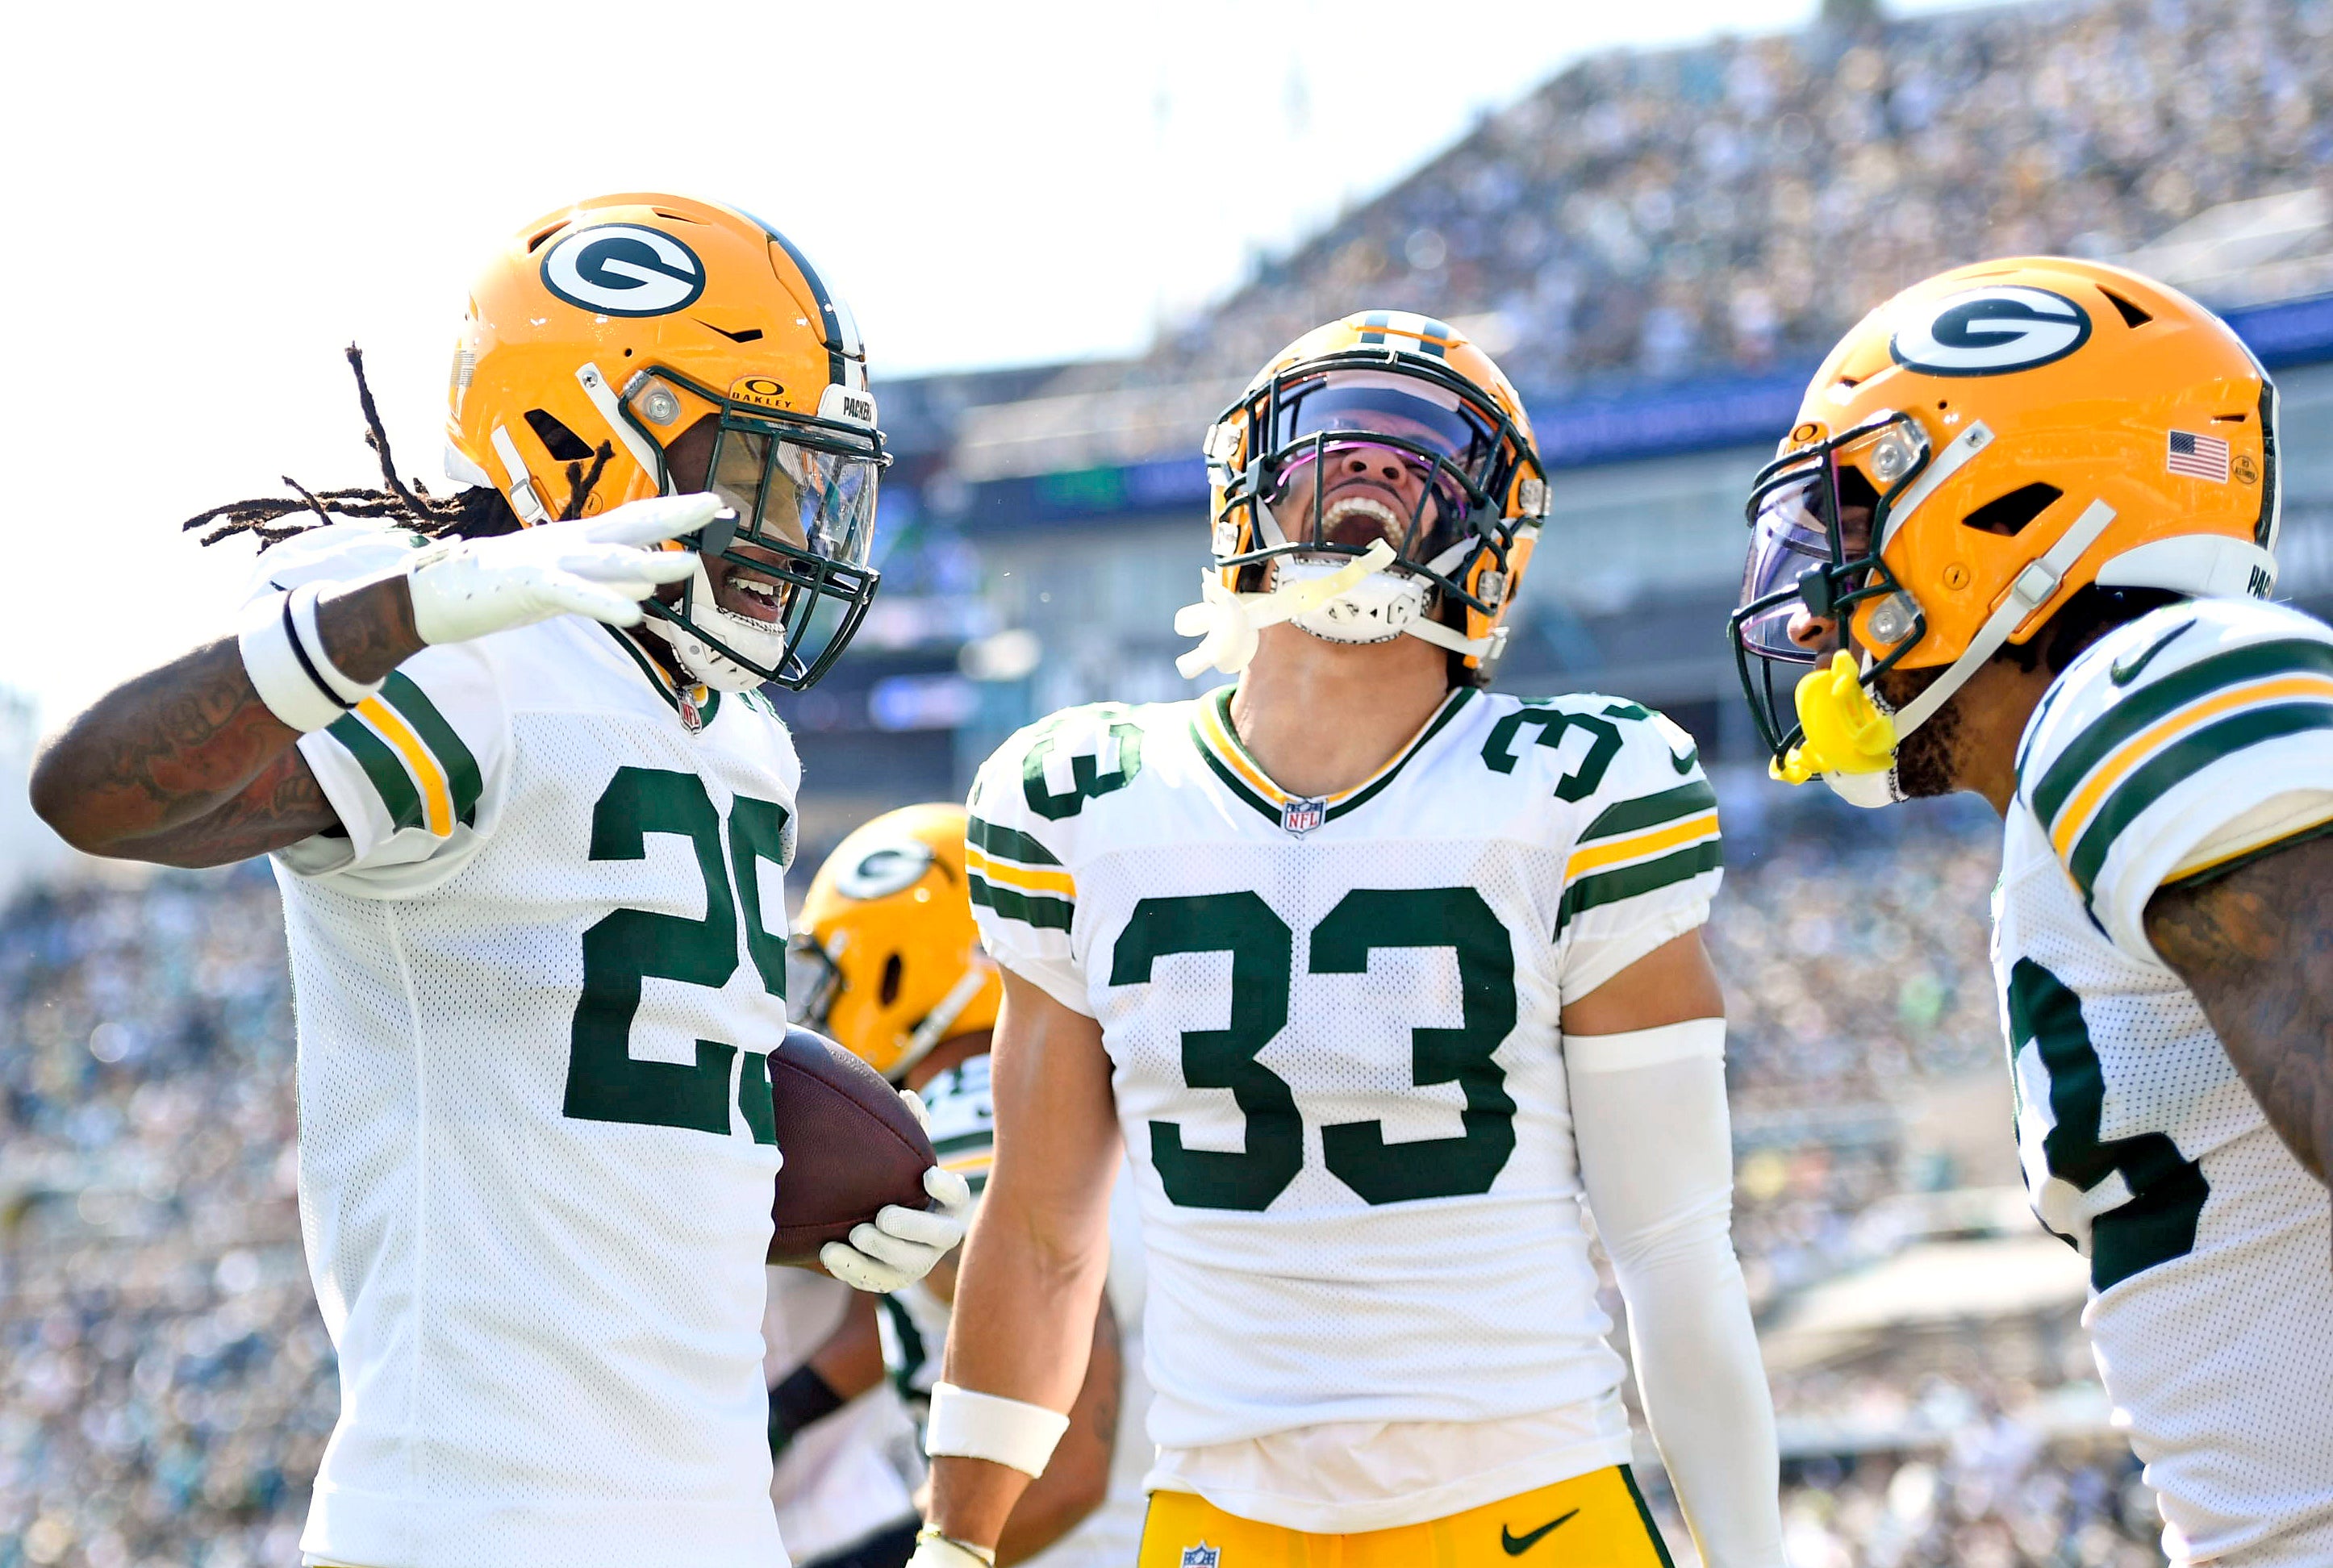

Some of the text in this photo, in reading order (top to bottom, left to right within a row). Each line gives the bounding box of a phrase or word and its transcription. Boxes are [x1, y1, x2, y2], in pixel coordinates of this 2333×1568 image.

[732, 392, 791, 408] OAKLEY
[682, 702, 699, 727] NFL
[1288, 812, 1317, 829] NFL
[1108, 886, 1518, 1212] 33
